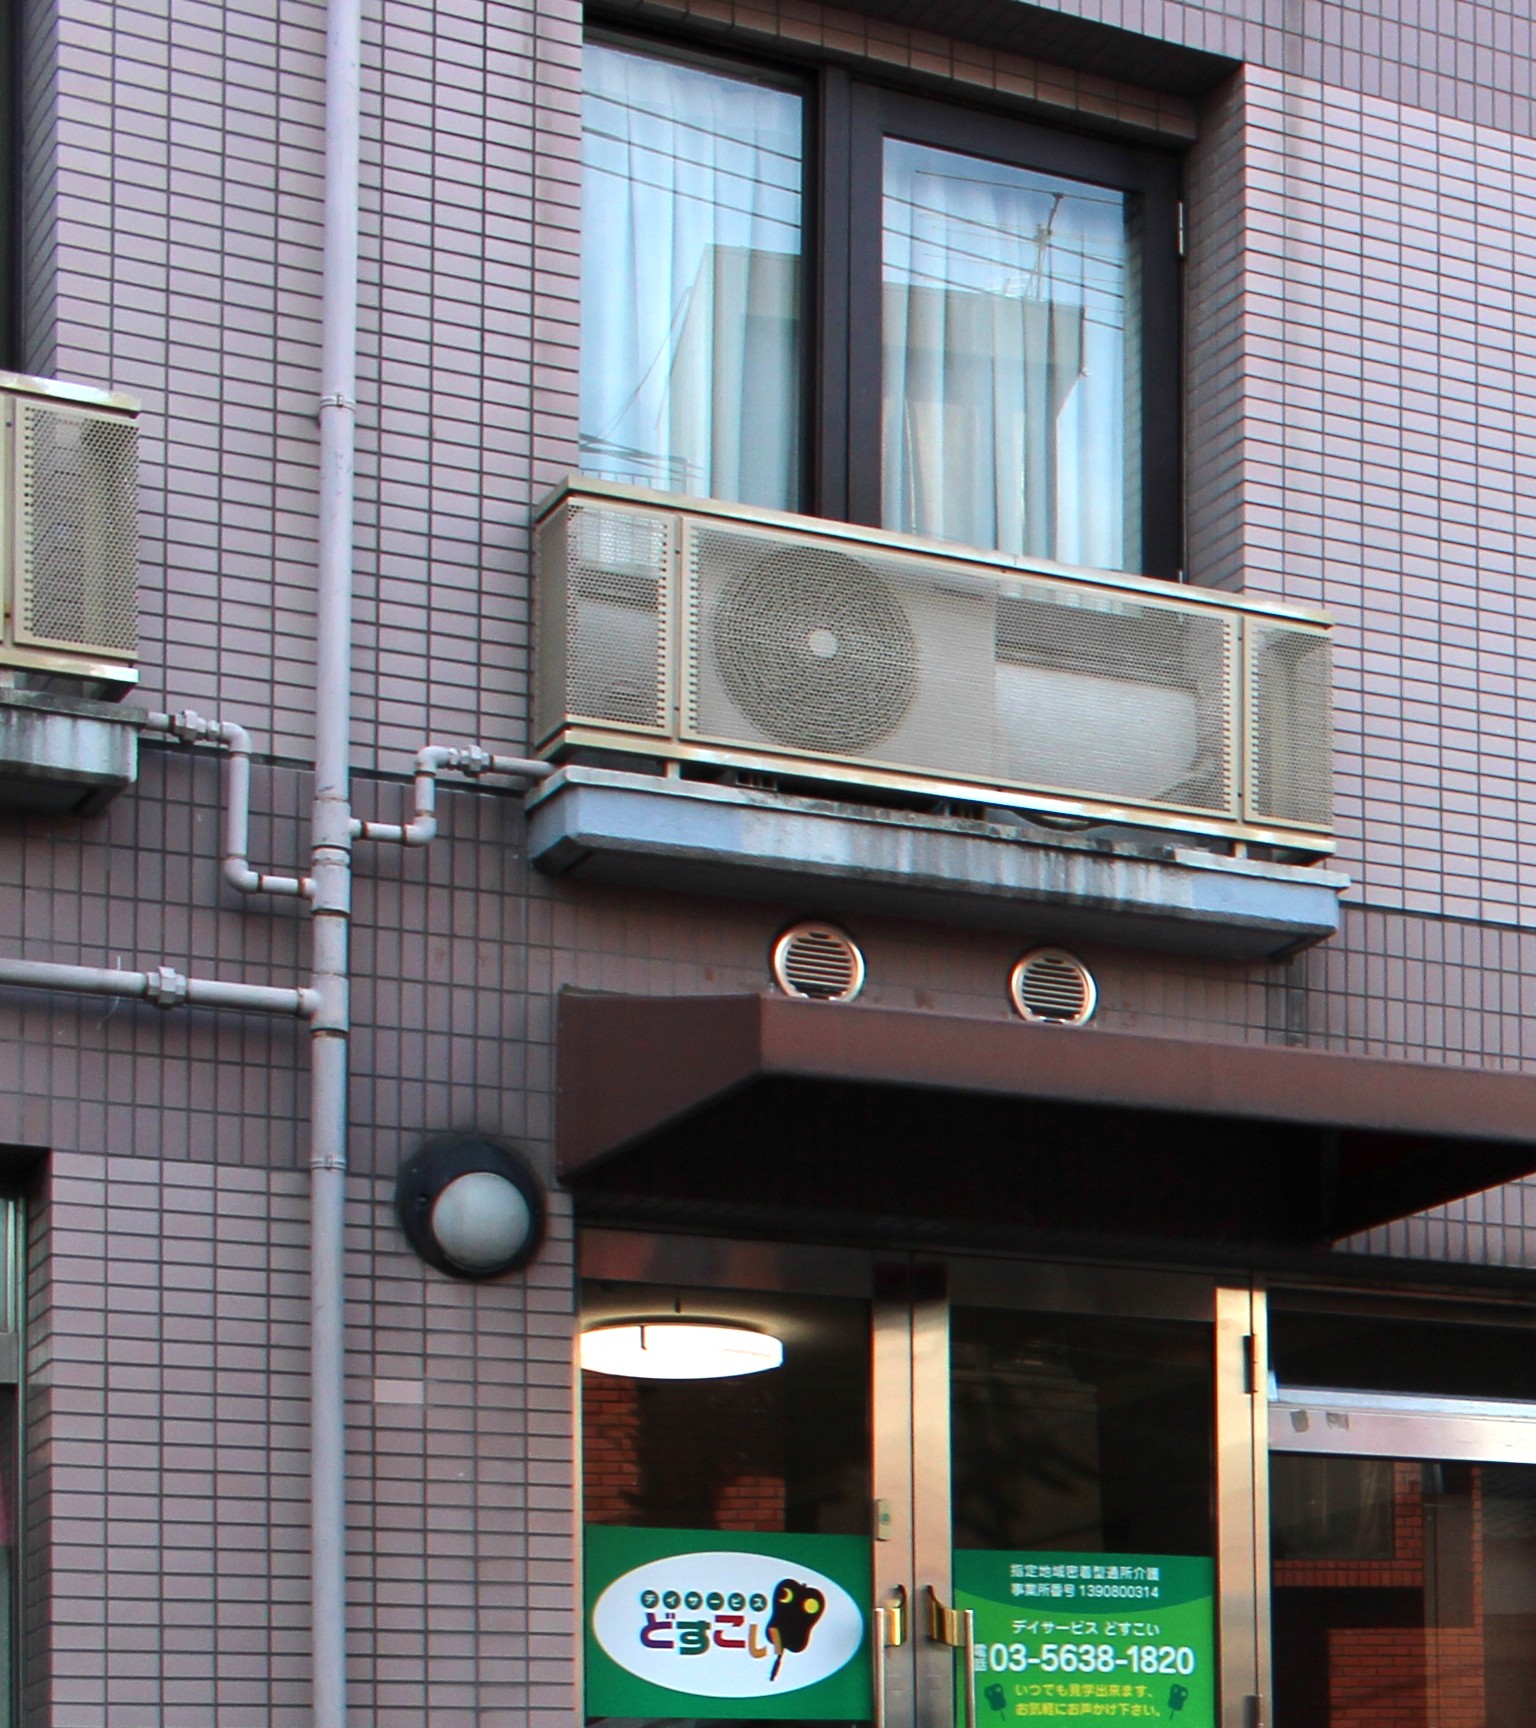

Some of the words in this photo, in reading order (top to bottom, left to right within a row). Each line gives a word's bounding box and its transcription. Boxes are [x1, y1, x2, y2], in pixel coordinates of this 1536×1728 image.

[1010, 1583, 1076, 1598] 事業所番号
[640, 1612, 782, 1658] どすこい
[1011, 1619, 1099, 1635] デイサービス
[1104, 1620, 1161, 1636] どすこい
[990, 1643, 1194, 1674] 03-5638-1820
